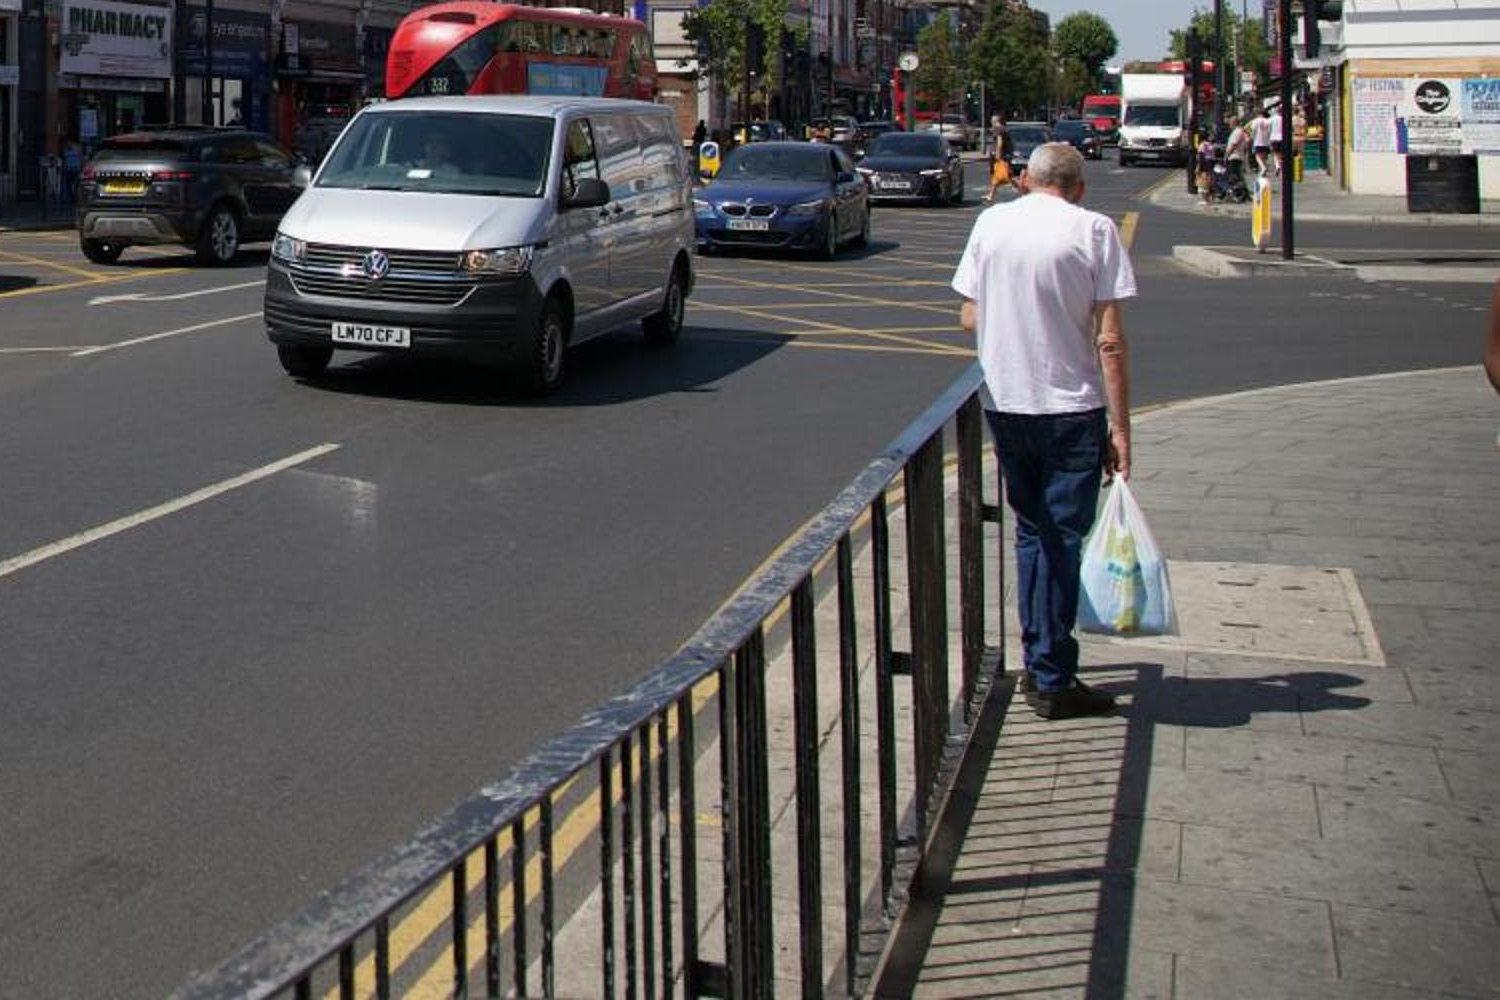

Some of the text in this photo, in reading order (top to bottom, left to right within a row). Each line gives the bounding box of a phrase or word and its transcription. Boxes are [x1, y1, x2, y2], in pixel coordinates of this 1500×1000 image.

[69, 7, 166, 40] PHARMACY
[430, 77, 450, 93] 332
[337, 325, 404, 343] LM70 CFJ
